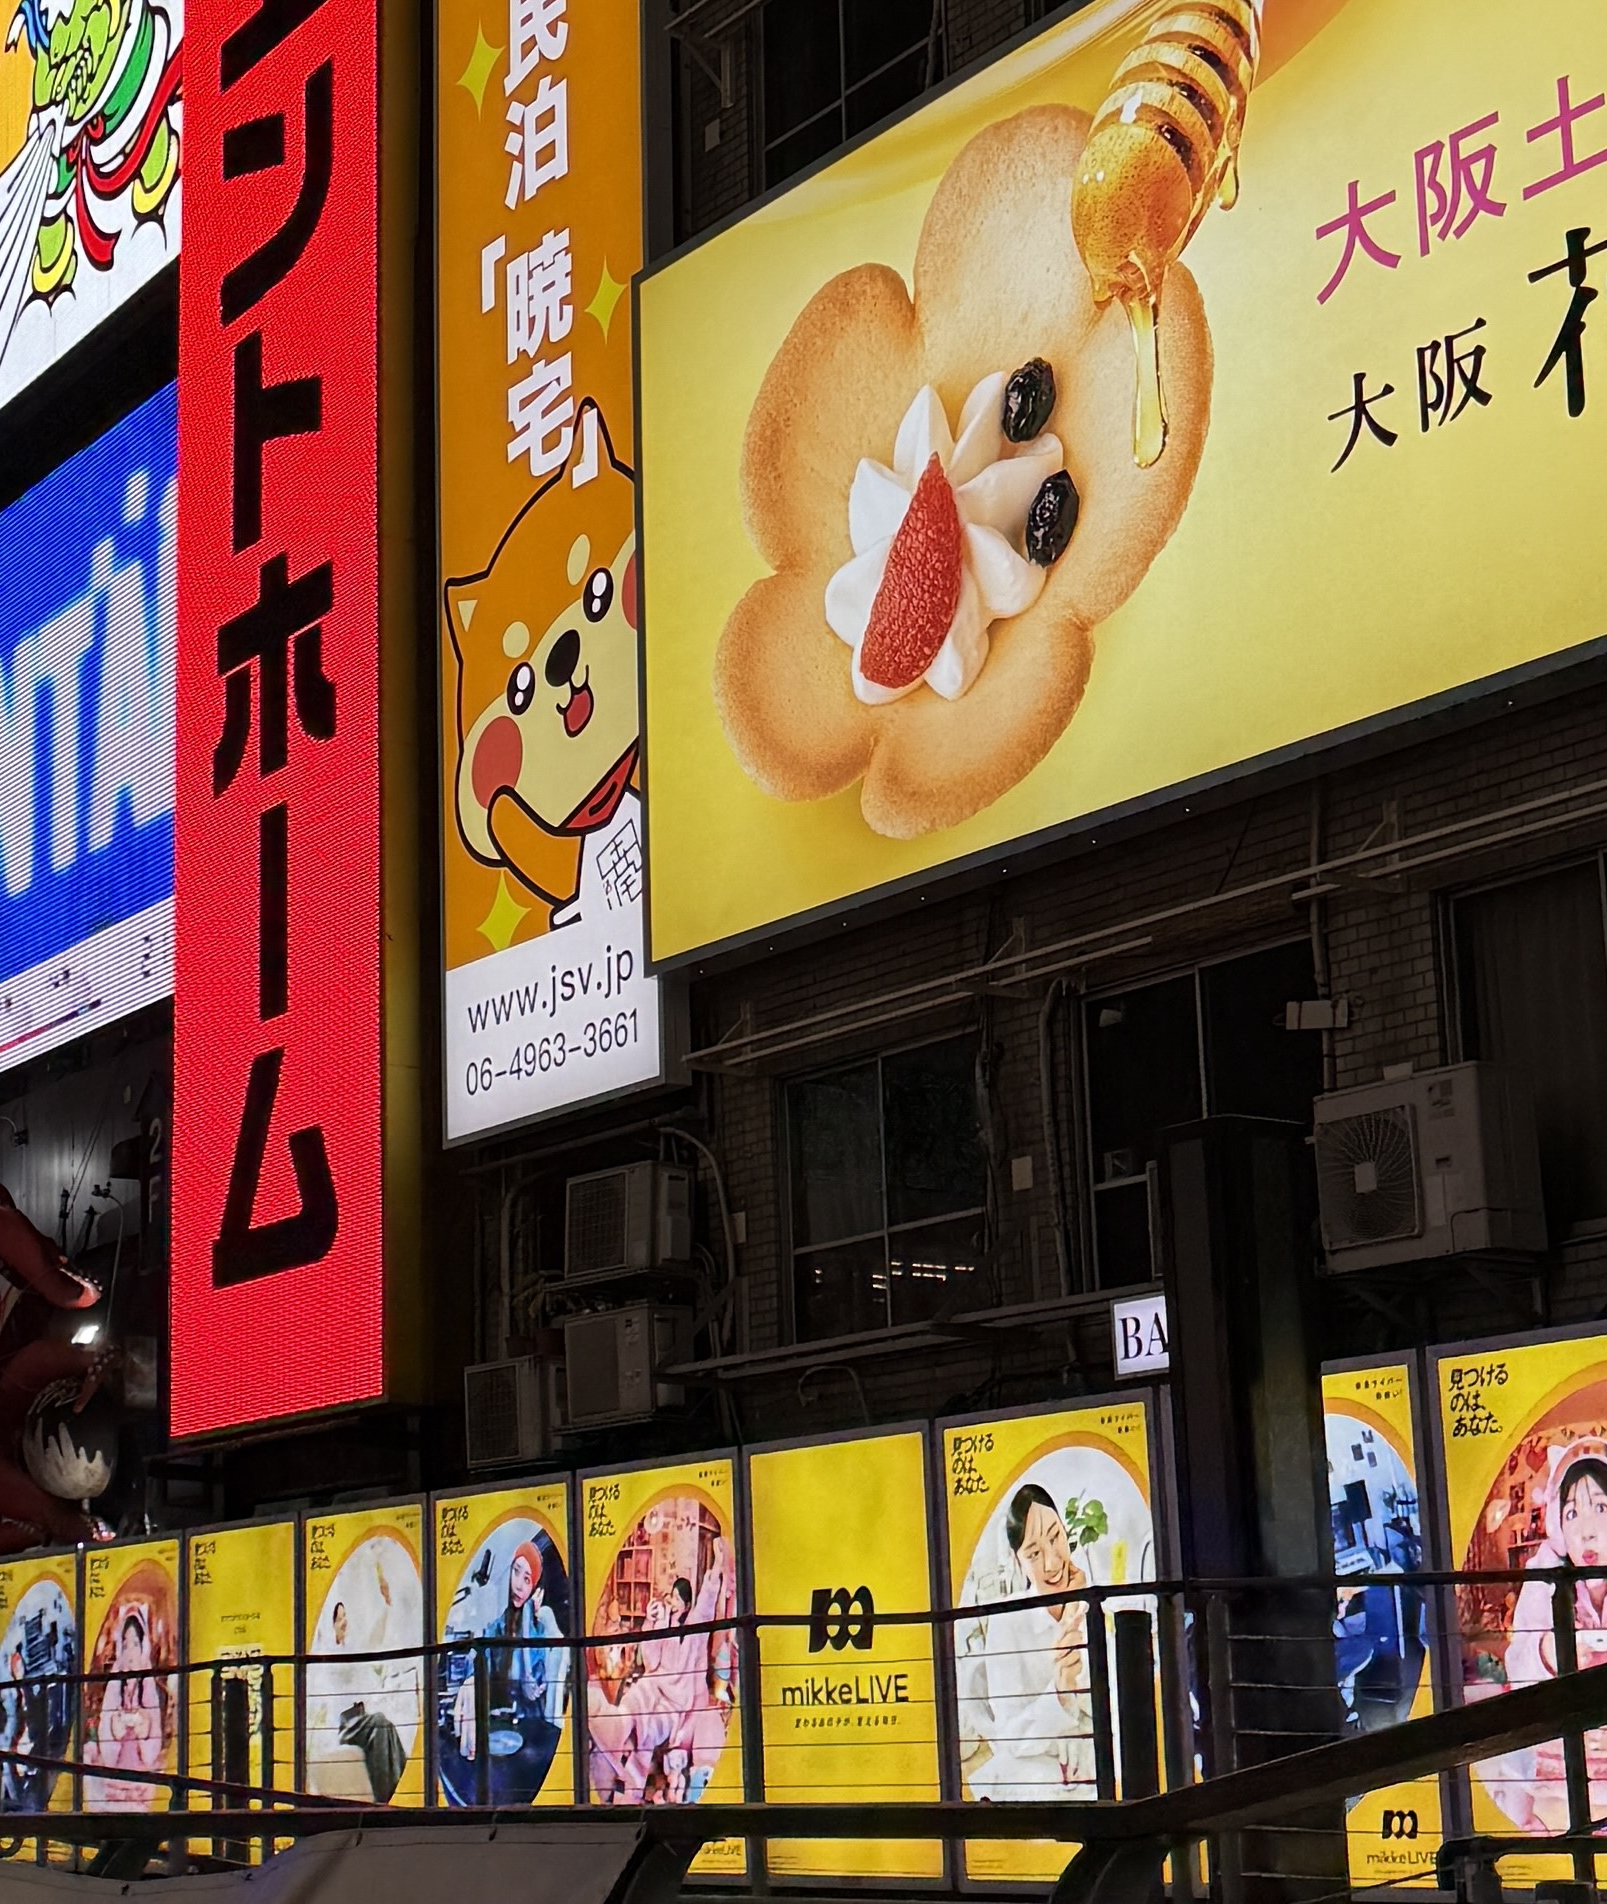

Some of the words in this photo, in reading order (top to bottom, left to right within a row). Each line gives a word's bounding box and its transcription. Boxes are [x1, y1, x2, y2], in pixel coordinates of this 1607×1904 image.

[1328, 316, 1493, 473] 大阪
[467, 944, 635, 1034] www.jsv.jp
[466, 1007, 639, 1096] 06-4963-3661
[1118, 1311, 1170, 1361] BA
[1449, 1363, 1509, 1392] 見つける
[951, 1433, 994, 1457] 見つける
[1452, 1412, 1503, 1438] あなた。
[781, 1673, 910, 1706] mikkeLIVE
